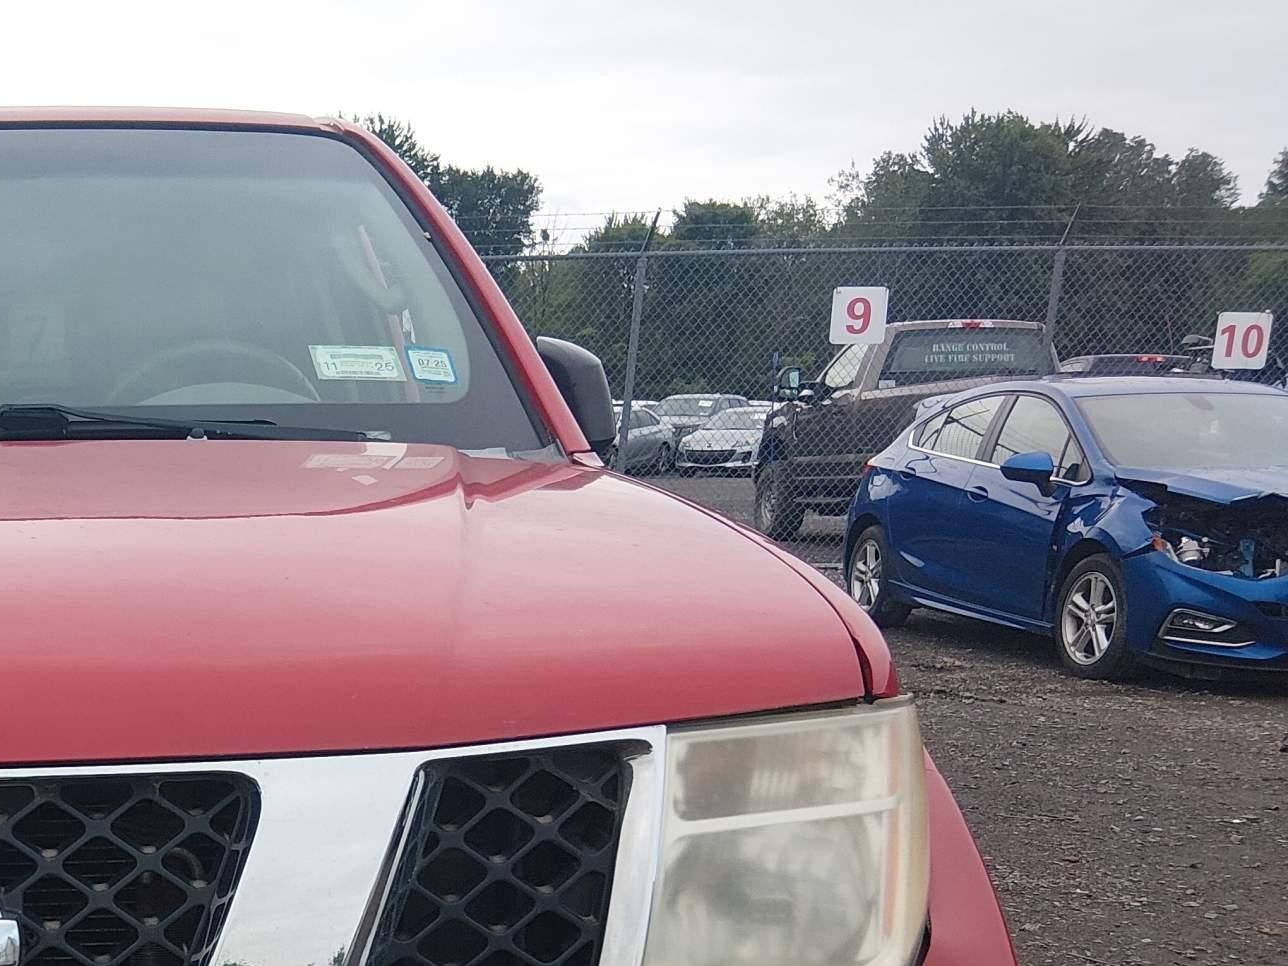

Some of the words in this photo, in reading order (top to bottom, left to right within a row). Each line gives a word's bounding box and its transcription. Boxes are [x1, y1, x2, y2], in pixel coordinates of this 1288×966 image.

[846, 297, 872, 334] 9
[1221, 323, 1265, 358] 10
[966, 341, 1009, 352] CONTROL
[972, 353, 1016, 362] SUPPORT
[375, 361, 395, 372] 25
